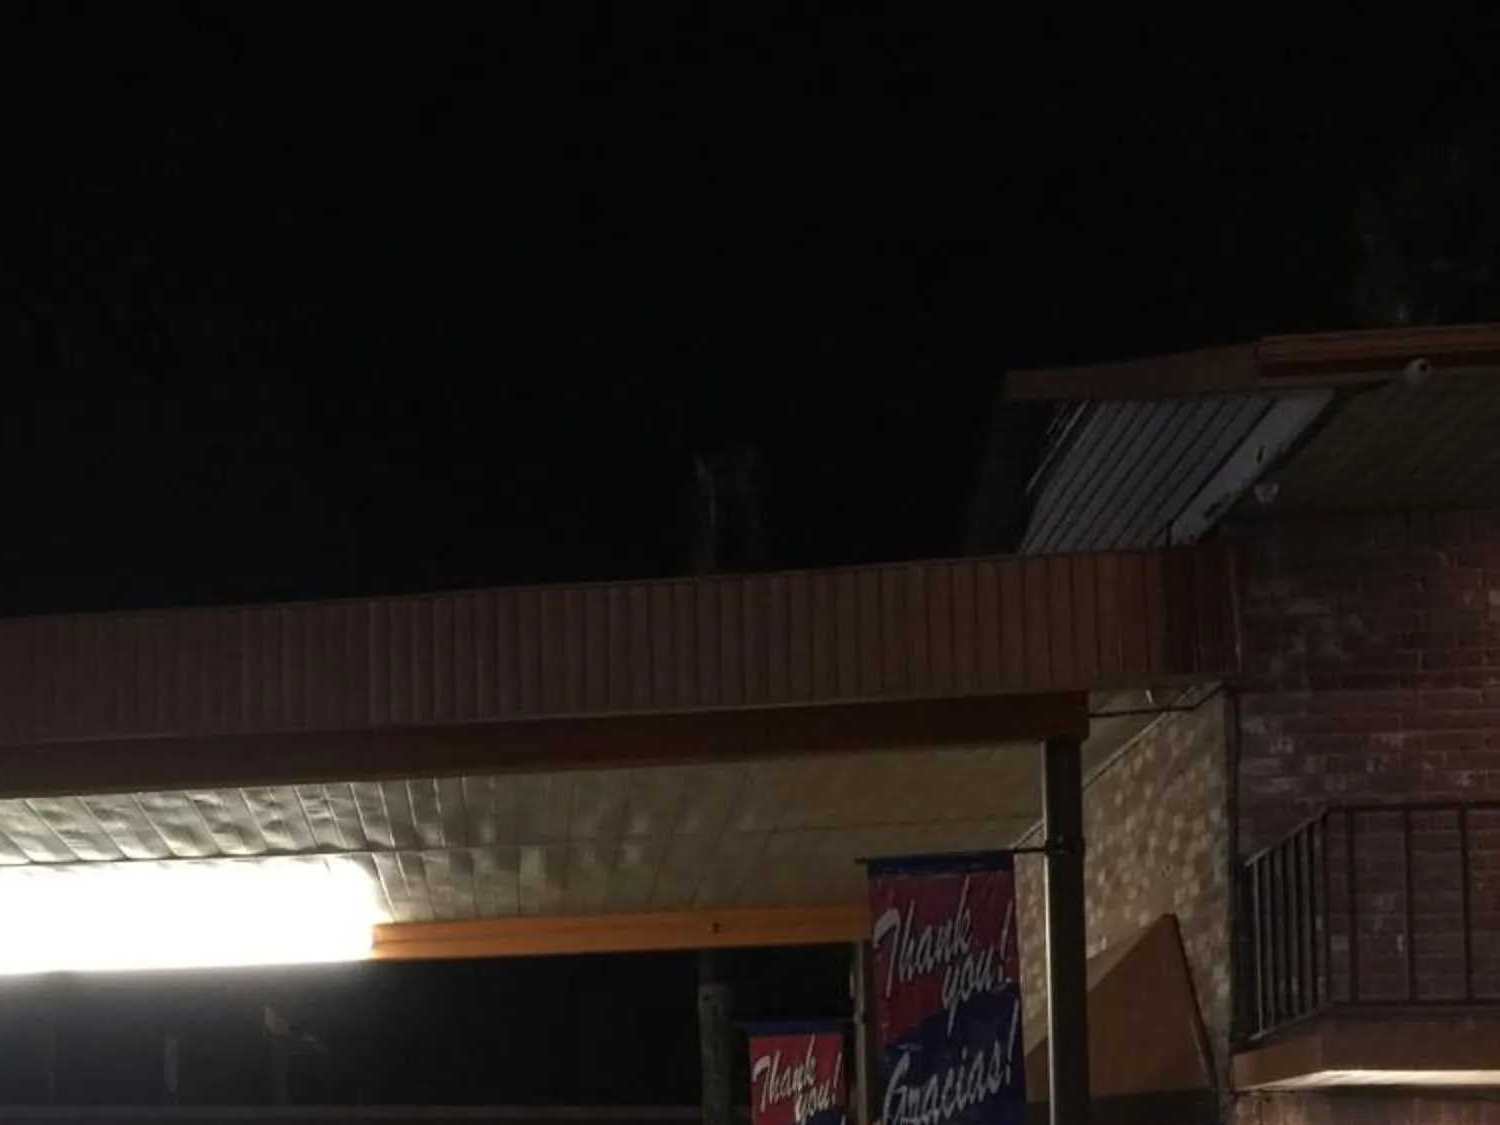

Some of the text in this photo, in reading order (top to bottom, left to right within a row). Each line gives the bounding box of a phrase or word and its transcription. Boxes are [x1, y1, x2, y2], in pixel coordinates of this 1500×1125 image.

[873, 875, 973, 998] Thank
[943, 899, 1014, 1036] you!
[752, 1033, 817, 1113] Thank
